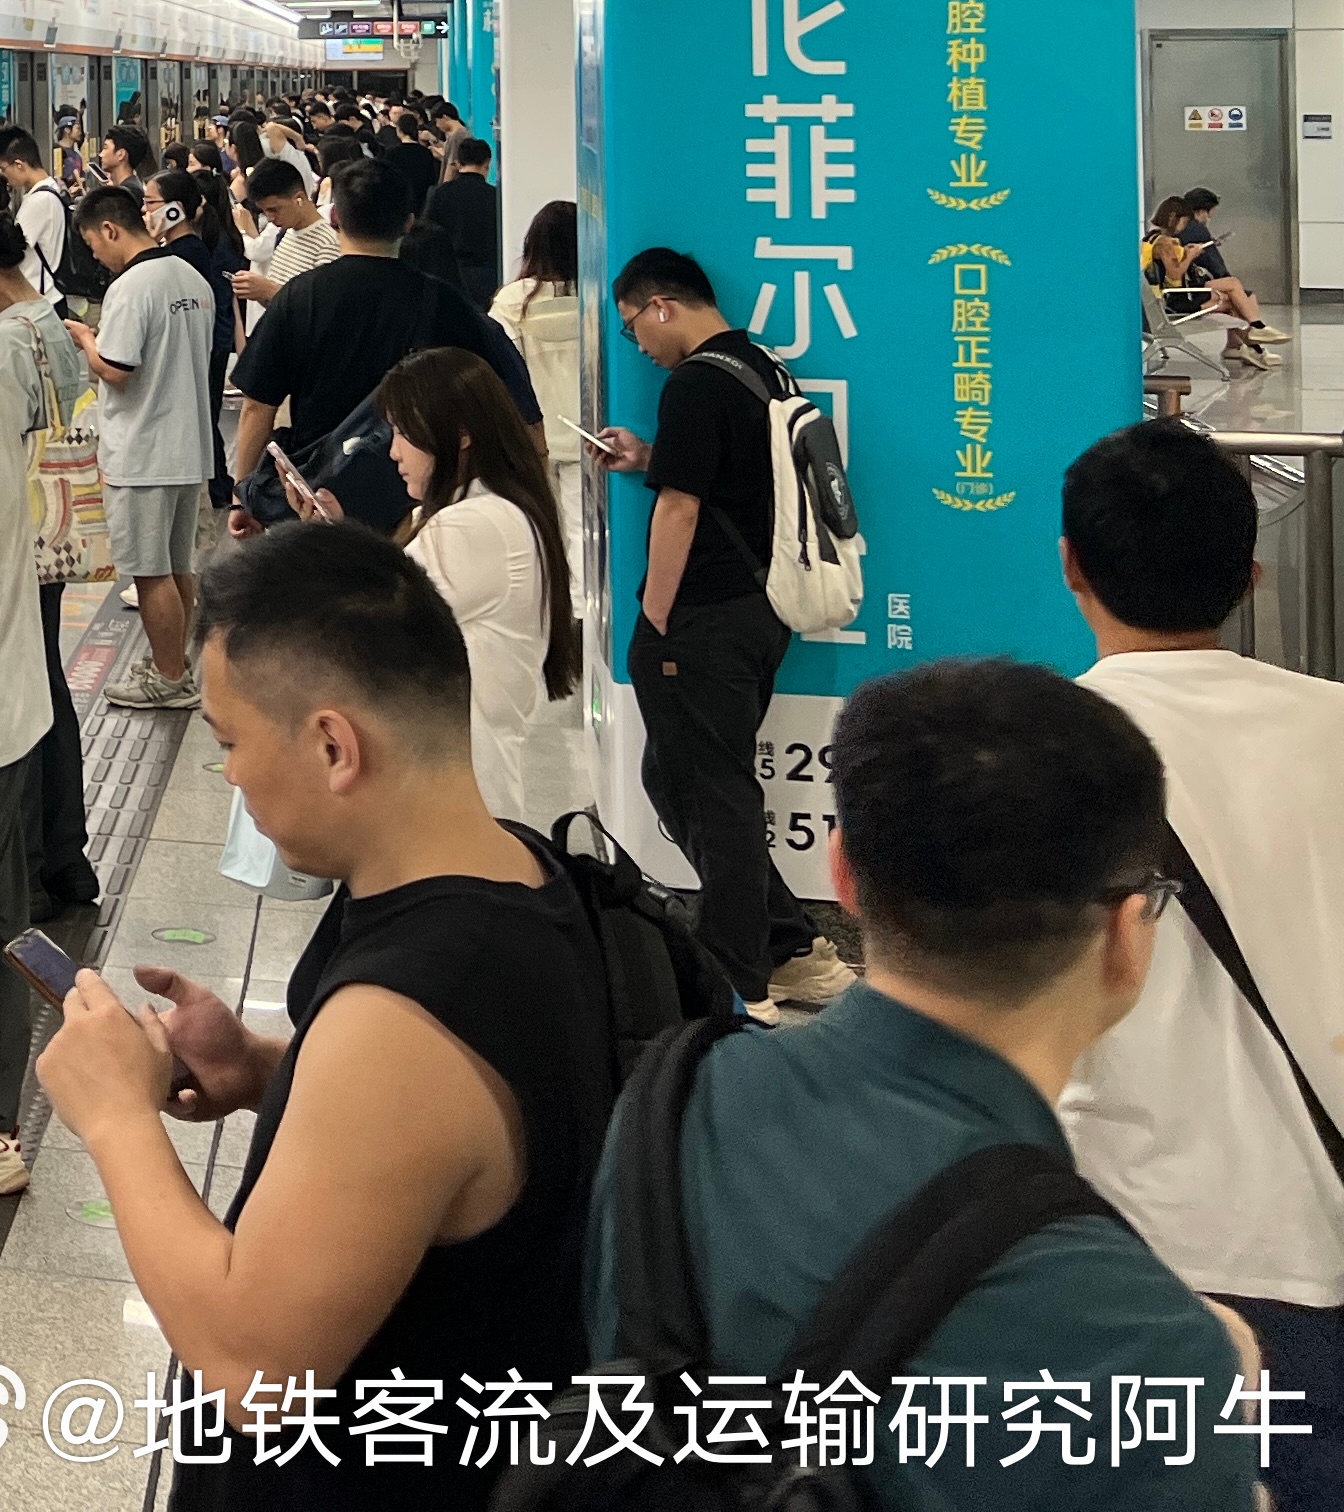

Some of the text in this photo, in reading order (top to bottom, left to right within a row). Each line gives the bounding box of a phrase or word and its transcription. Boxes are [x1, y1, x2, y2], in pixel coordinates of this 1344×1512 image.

[950, 263, 994, 478] 口腔正畸专业
[888, 593, 914, 650] 医院
